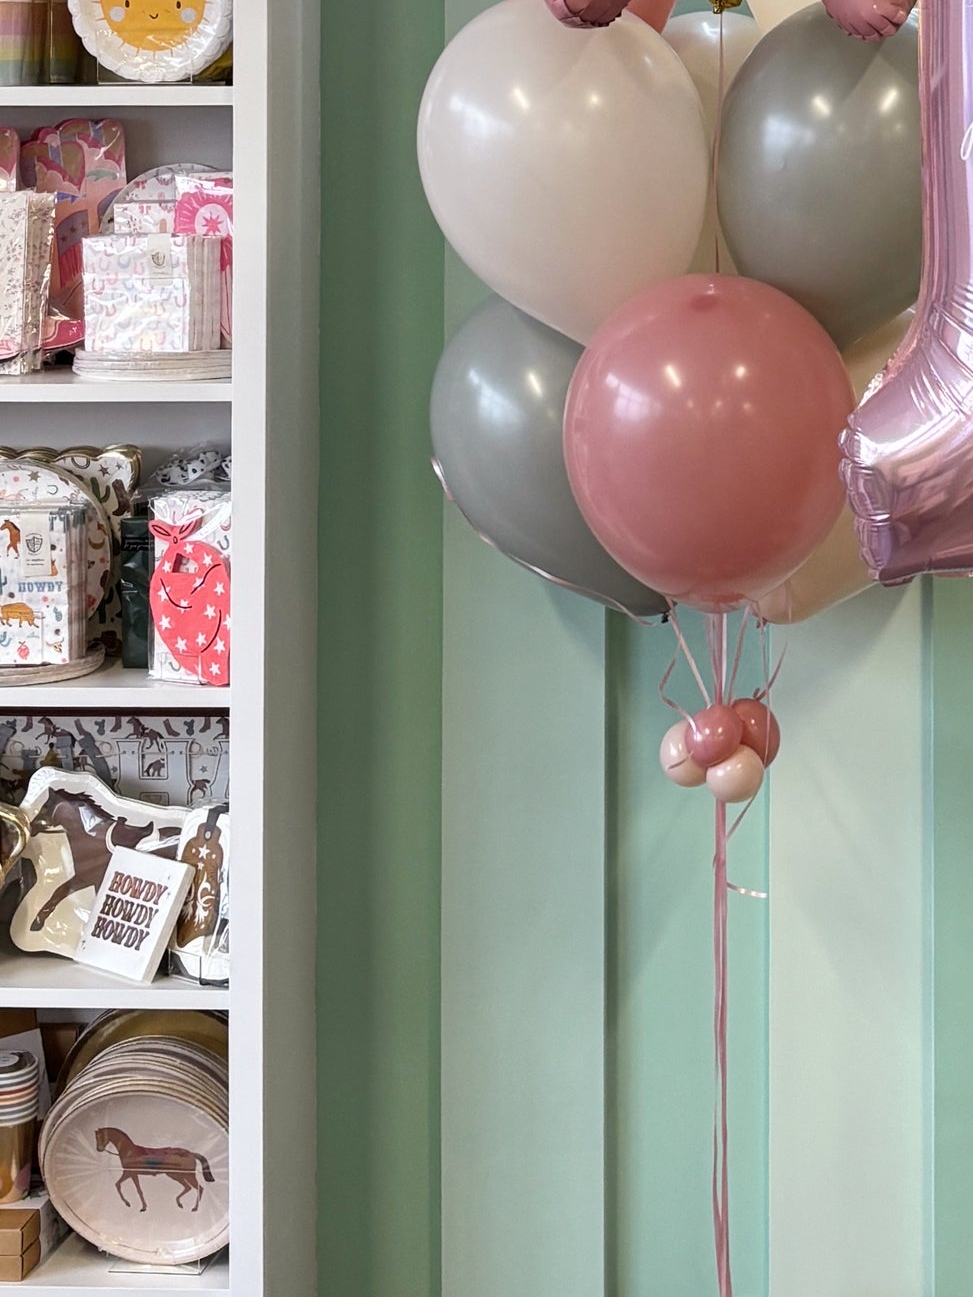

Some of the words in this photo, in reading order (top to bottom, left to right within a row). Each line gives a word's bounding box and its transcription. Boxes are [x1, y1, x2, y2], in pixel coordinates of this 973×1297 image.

[18, 581, 63, 592] HOWDY
[108, 871, 168, 905] HOWDY
[100, 894, 159, 928] HOWDY
[91, 916, 150, 951] HOWDY
